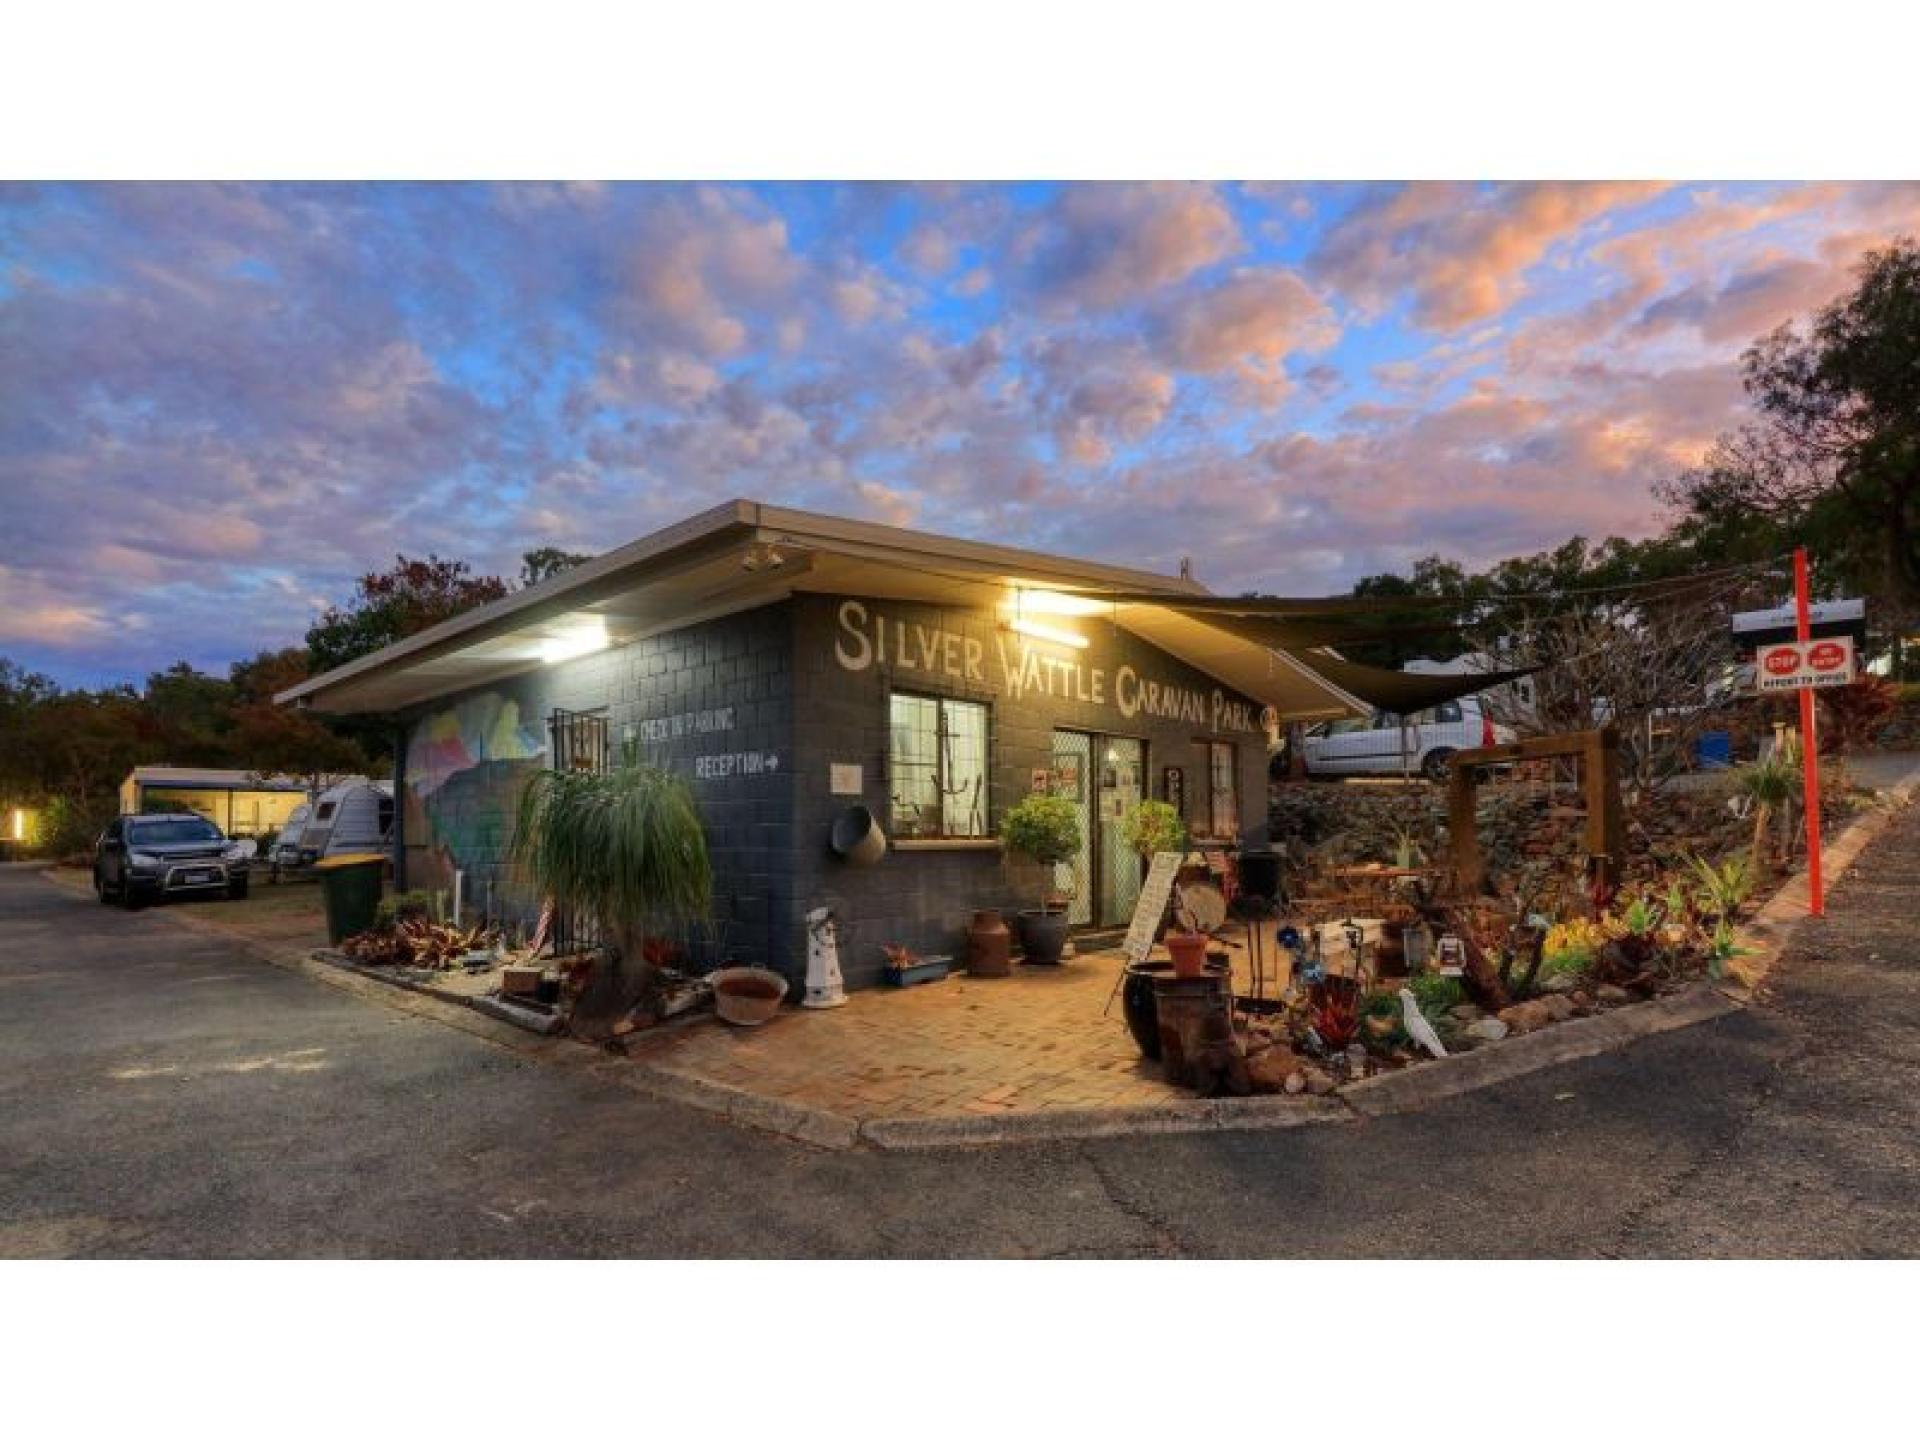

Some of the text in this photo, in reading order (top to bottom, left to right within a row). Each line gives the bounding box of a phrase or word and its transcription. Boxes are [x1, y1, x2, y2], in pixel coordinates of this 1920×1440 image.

[835, 601, 985, 681] SILVER
[1116, 665, 1206, 723] CARAVAN
[1212, 688, 1252, 733] PARK
[695, 752, 764, 779] RECEPTION
